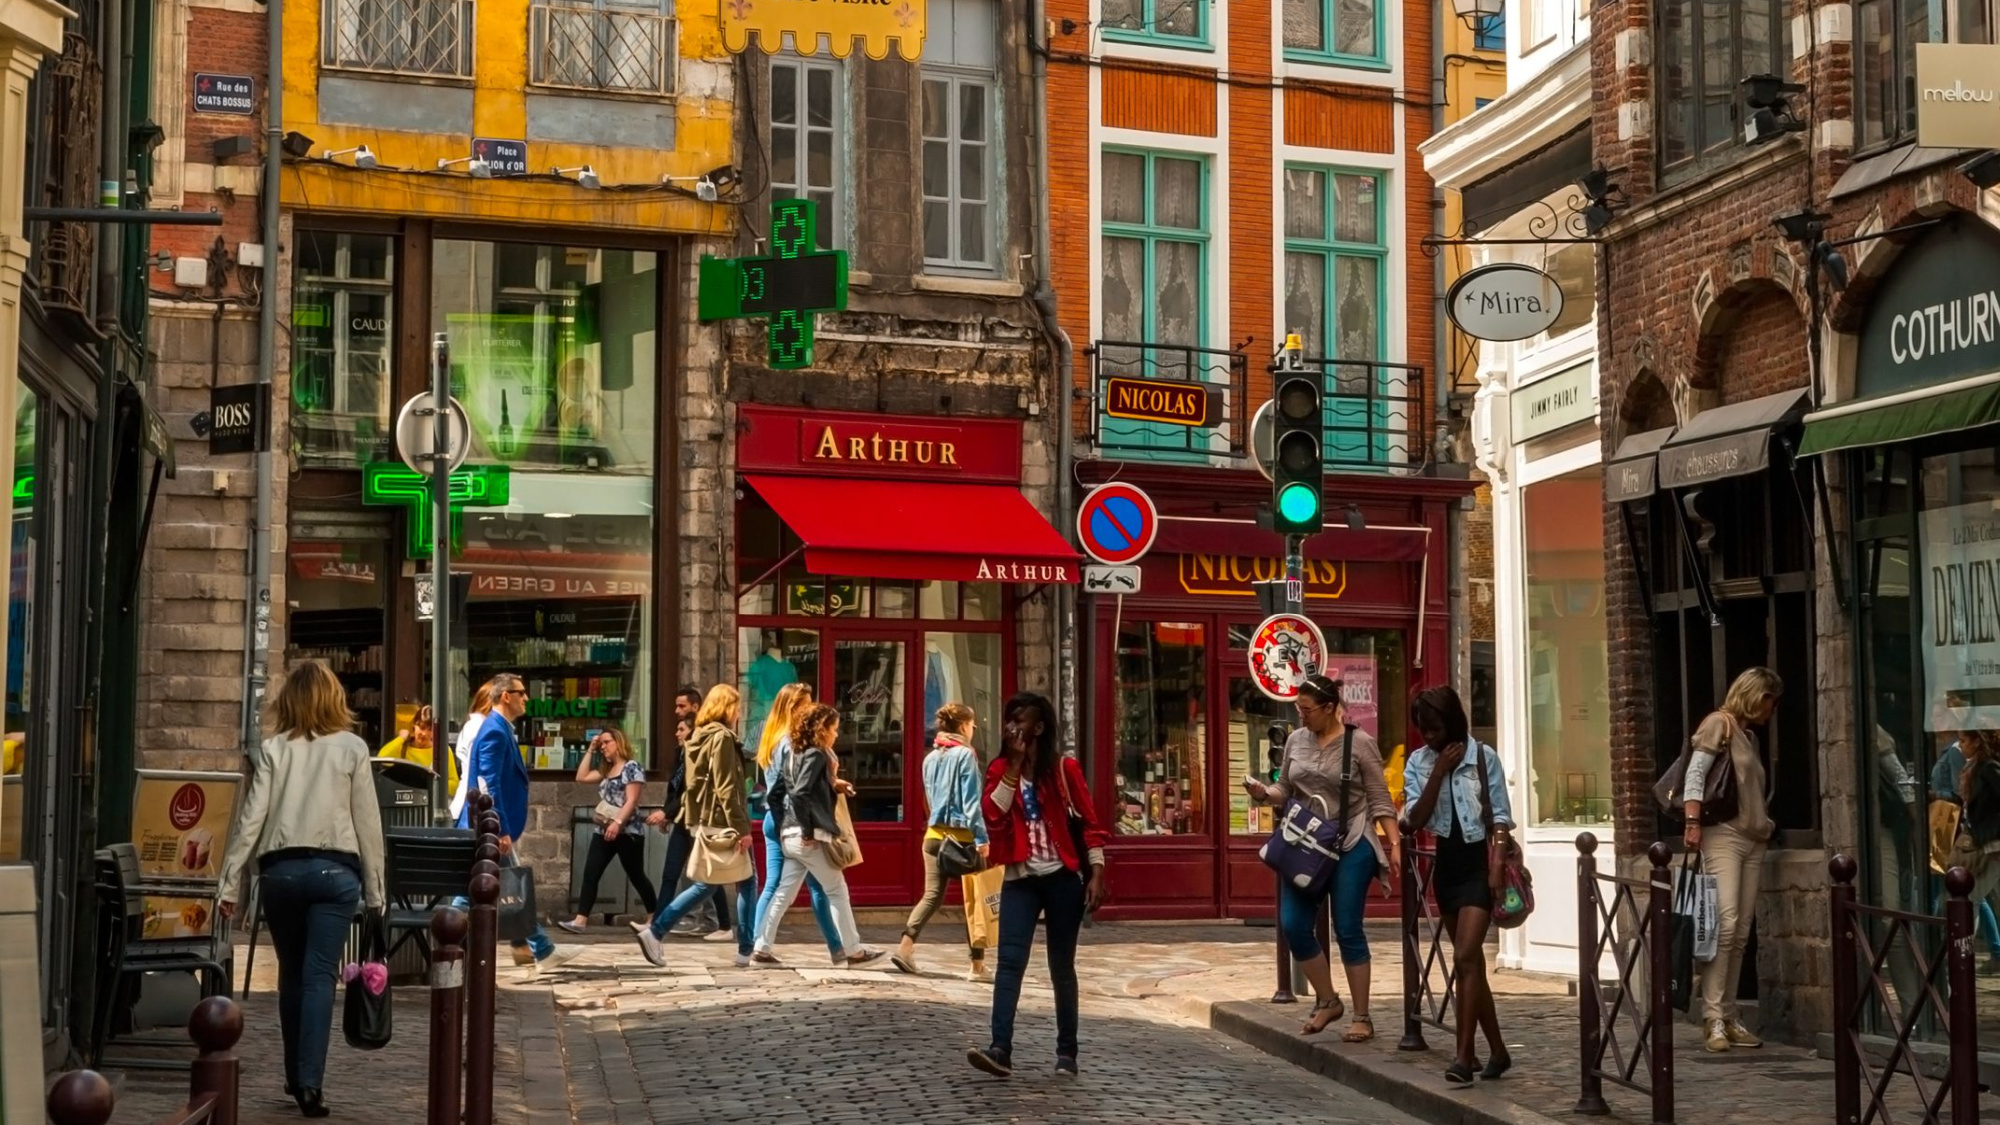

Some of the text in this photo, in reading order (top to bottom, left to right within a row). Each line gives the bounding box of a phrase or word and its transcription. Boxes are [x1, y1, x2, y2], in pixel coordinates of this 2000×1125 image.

[216, 81, 248, 93] Rue des
[1924, 80, 1993, 102] mellow
[197, 95, 252, 108] CHATS BOSSUS
[497, 146, 518, 156] Place
[1480, 291, 1542, 315] Mira
[1118, 386, 1196, 416] NICOLAS
[1531, 386, 1578, 420] JIMMY FAIRLY
[215, 402, 251, 429] BOSS
[1621, 468, 1639, 495] Mira
[1190, 553, 1337, 585] NICOAS
